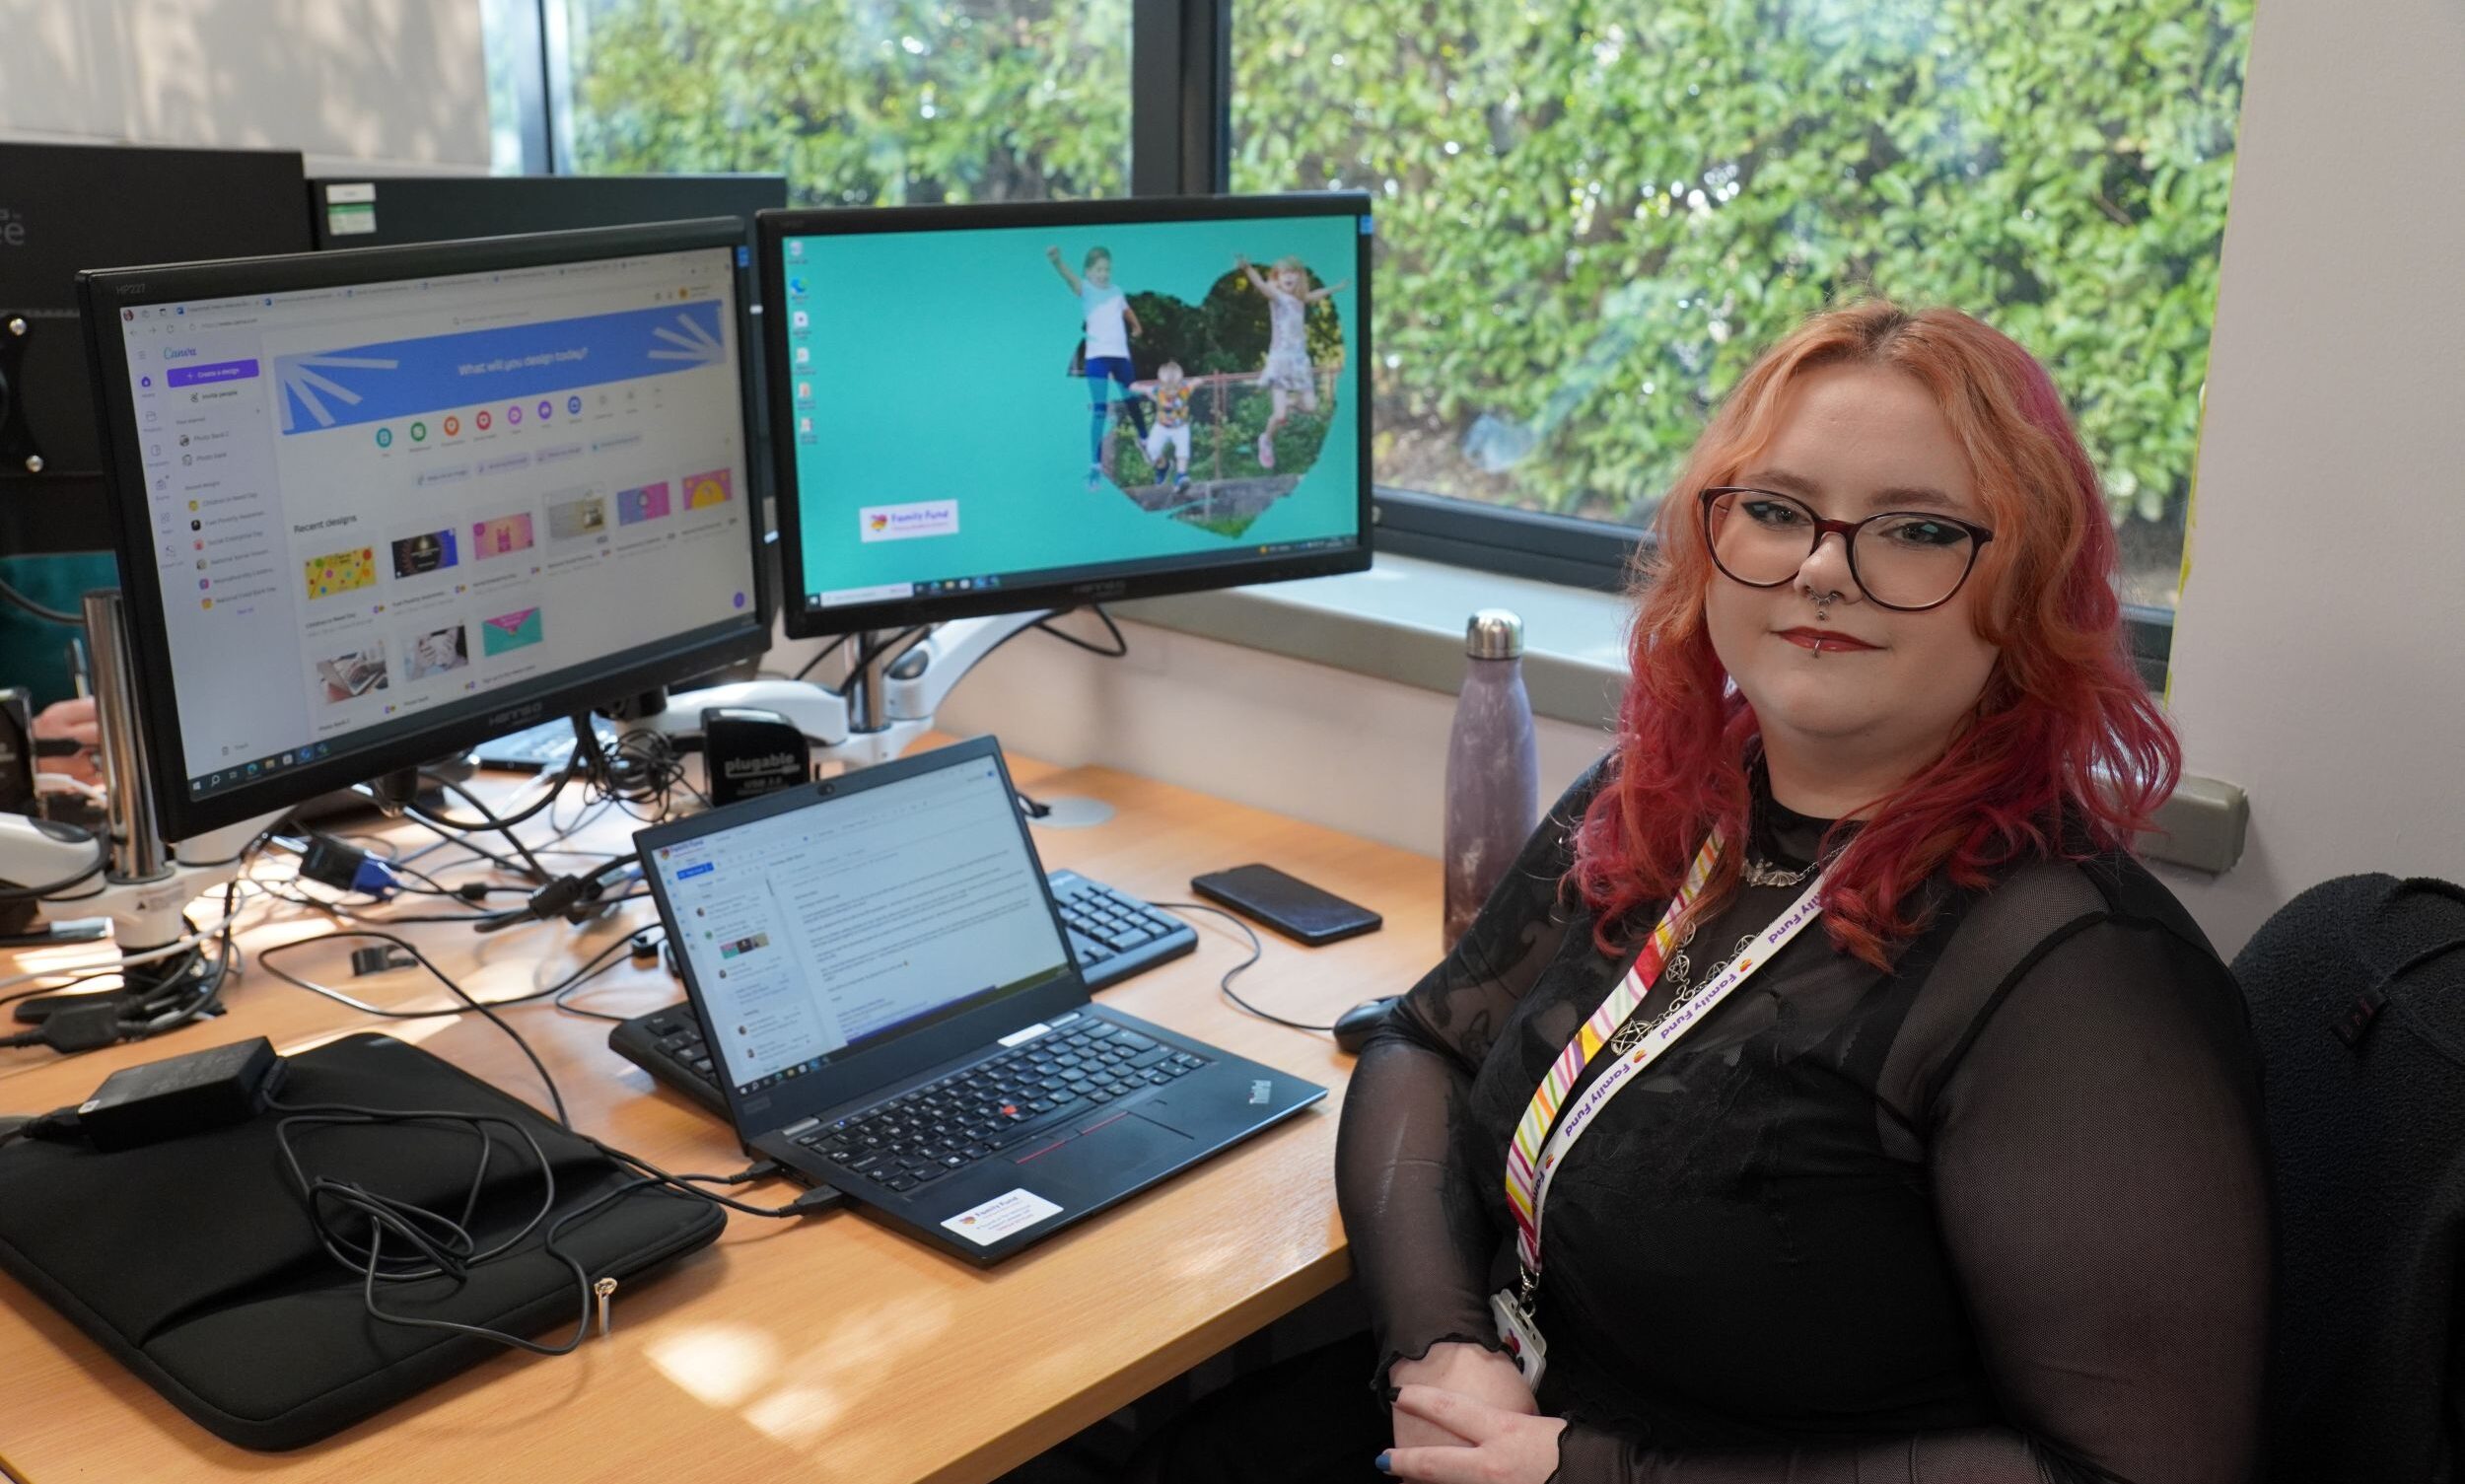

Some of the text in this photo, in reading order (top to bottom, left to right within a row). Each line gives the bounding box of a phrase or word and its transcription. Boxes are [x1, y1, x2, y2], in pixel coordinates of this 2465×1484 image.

[164, 346, 197, 361] Canva
[458, 347, 589, 376] What will you design today?
[294, 514, 358, 534] Recent designs
[891, 508, 950, 524] Family Fund
[725, 751, 795, 777] plugable
[1767, 913, 1802, 944] Fund
[1660, 972, 1737, 1039] Family Fund
[1565, 1062, 1632, 1137] Family Fund
